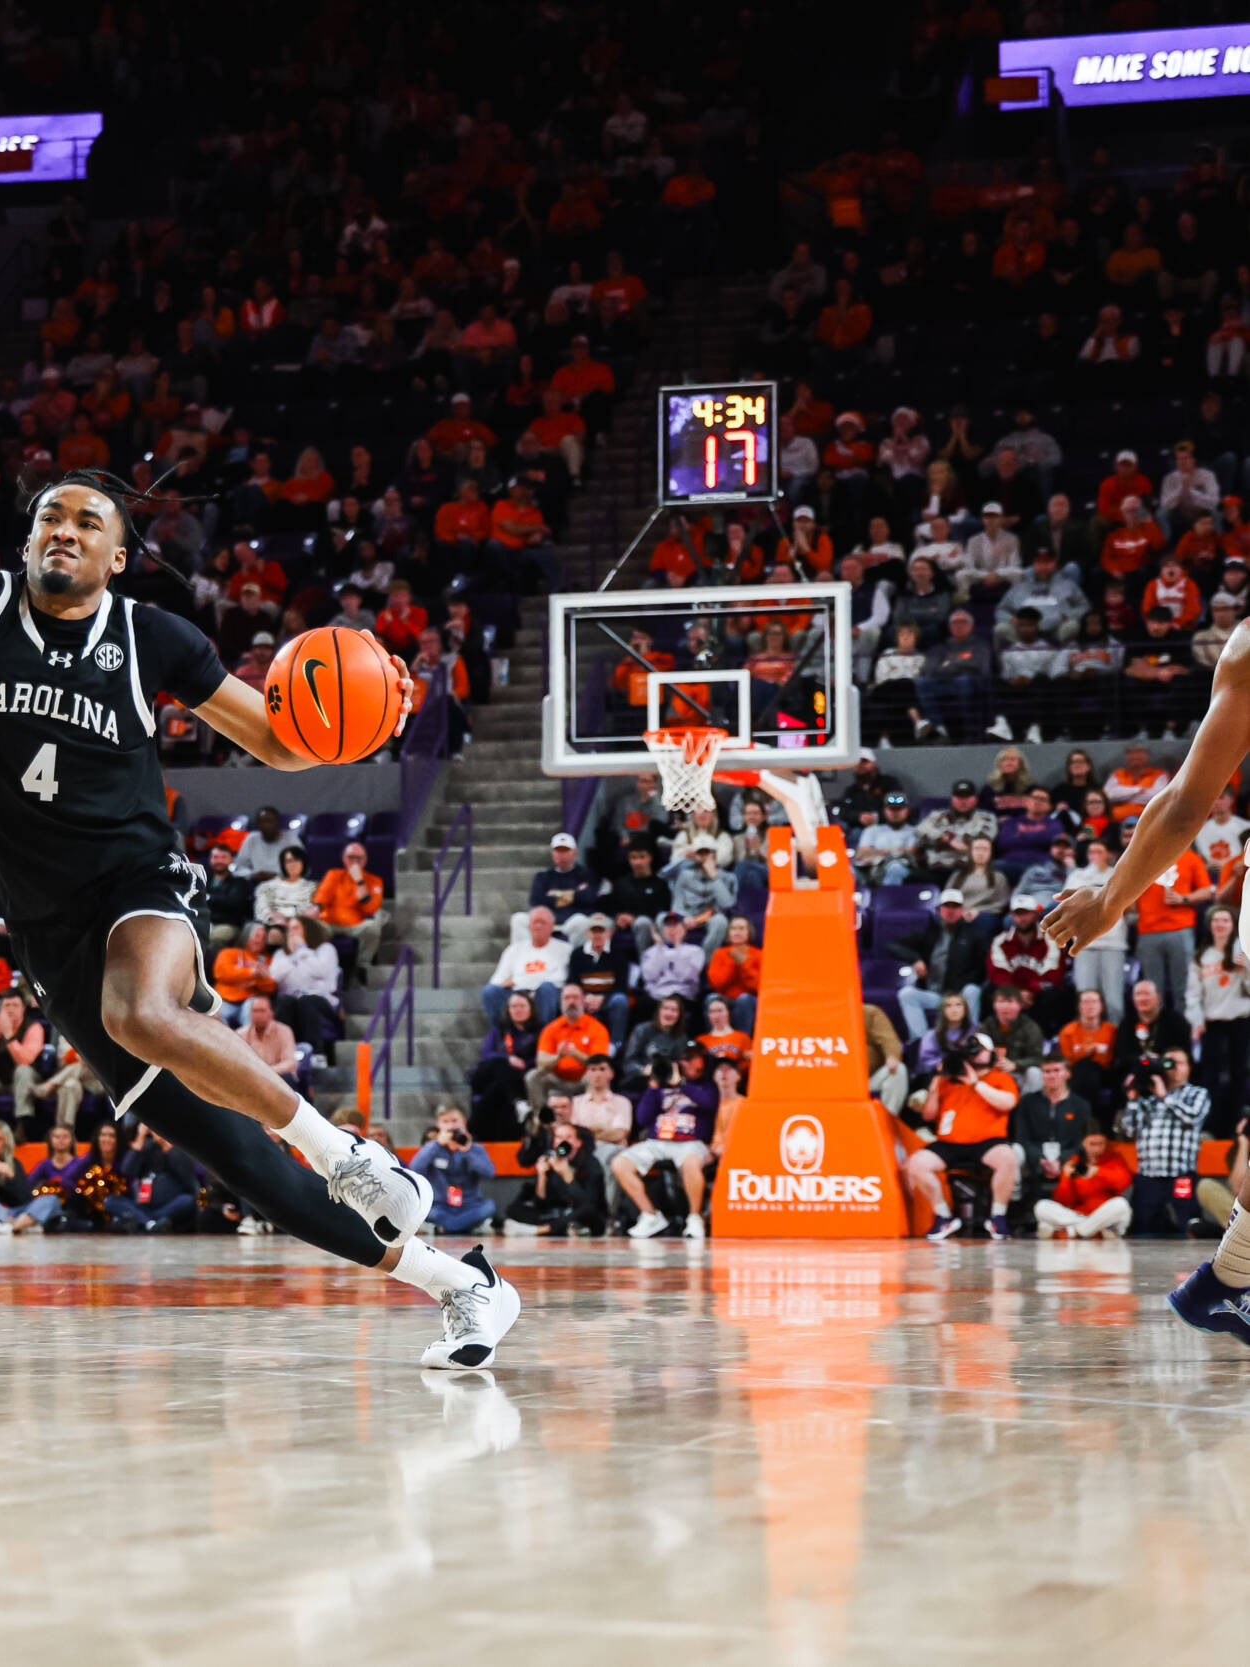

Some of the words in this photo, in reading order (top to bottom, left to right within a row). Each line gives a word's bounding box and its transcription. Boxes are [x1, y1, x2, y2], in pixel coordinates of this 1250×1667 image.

[1073, 53, 1147, 85] MAKE
[1149, 48, 1220, 79] SOME
[692, 395, 765, 428] 4:34
[705, 430, 757, 488] 17
[98, 645, 121, 668] SEC
[21, 743, 59, 802] 4
[761, 1036, 849, 1055] PRISMA
[727, 1168, 882, 1202] FOUNDERS
